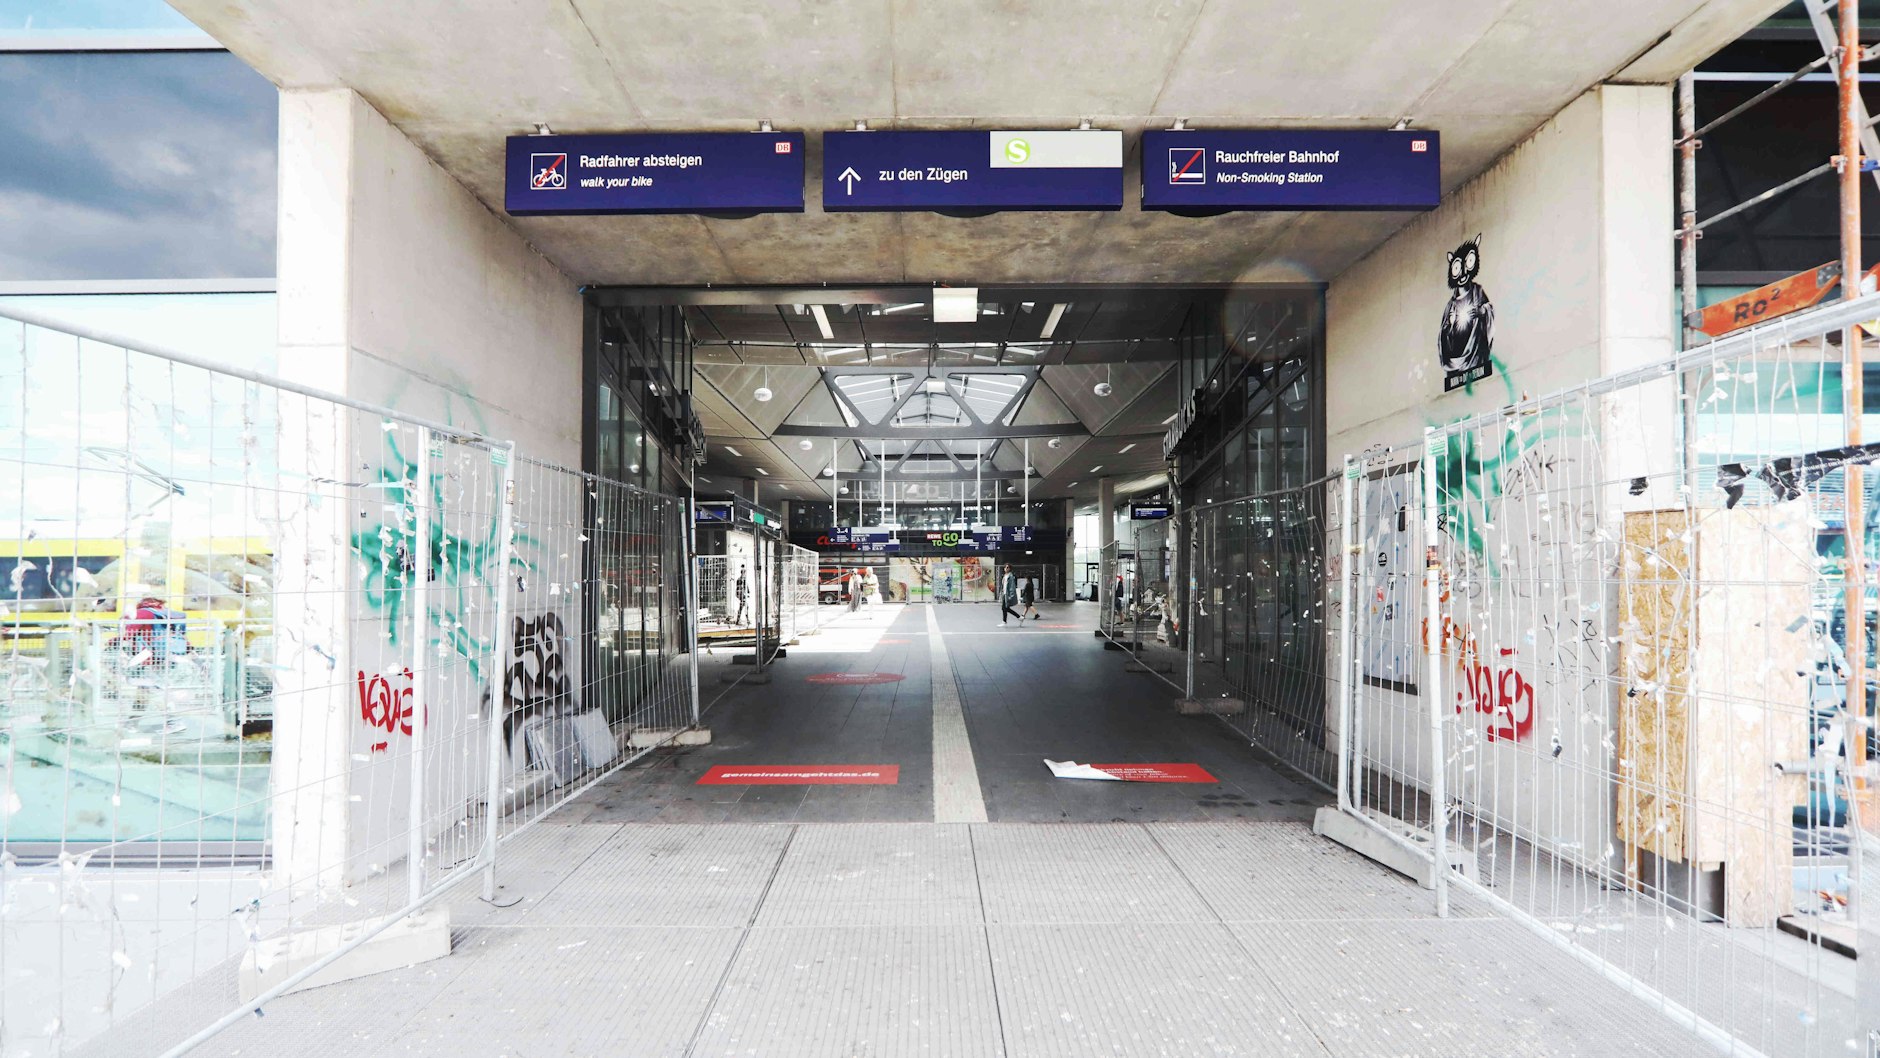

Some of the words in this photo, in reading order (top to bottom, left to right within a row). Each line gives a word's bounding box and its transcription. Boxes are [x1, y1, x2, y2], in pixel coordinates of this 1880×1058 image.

[777, 143, 790, 152] DB
[1008, 139, 1027, 162] S
[1412, 142, 1426, 150] DB
[579, 154, 641, 168] Radfahrer
[642, 153, 703, 170] absteigen
[1215, 150, 1286, 164] Rauchfreier
[1288, 150, 1340, 164] Bahnhof
[580, 176, 605, 188] walk
[606, 177, 630, 190] your
[631, 175, 653, 187] bike
[878, 170, 895, 181] zu
[898, 167, 923, 181] den
[926, 167, 968, 184] Zügen
[1216, 171, 1286, 186] Non-Smoking
[1287, 171, 1324, 184] Station
[943, 532, 959, 543] GO
[720, 771, 880, 779] gemeinsamgehtdas.de
